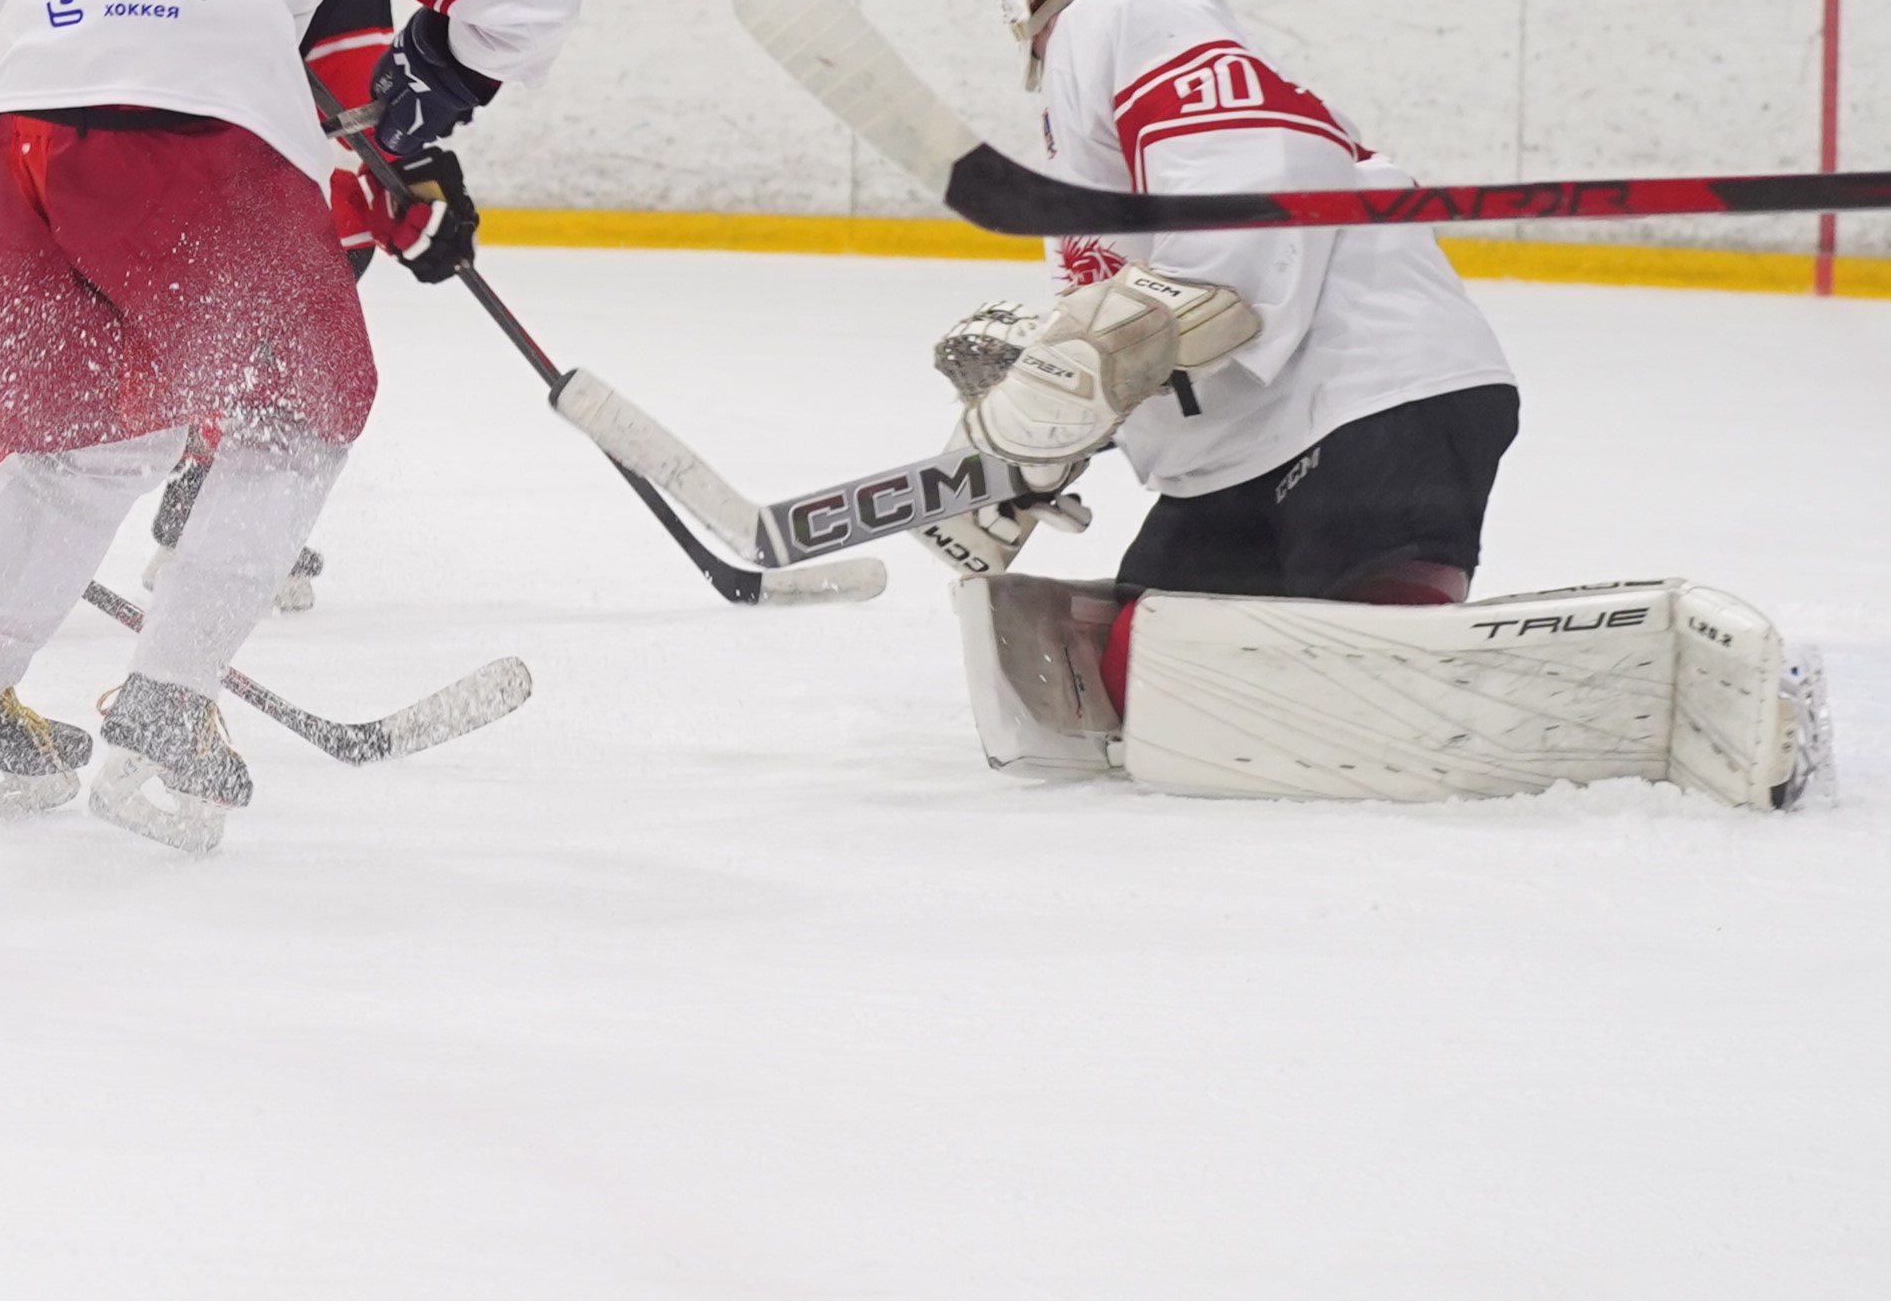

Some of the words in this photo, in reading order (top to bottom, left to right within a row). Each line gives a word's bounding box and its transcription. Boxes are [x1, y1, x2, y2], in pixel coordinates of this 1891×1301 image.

[104, 2, 180, 19] хоккея
[1173, 55, 1265, 114] 30
[1135, 278, 1182, 298] CCM
[789, 450, 991, 553] CCM
[924, 525, 990, 573] CCM
[1471, 607, 1650, 639] TRUE
